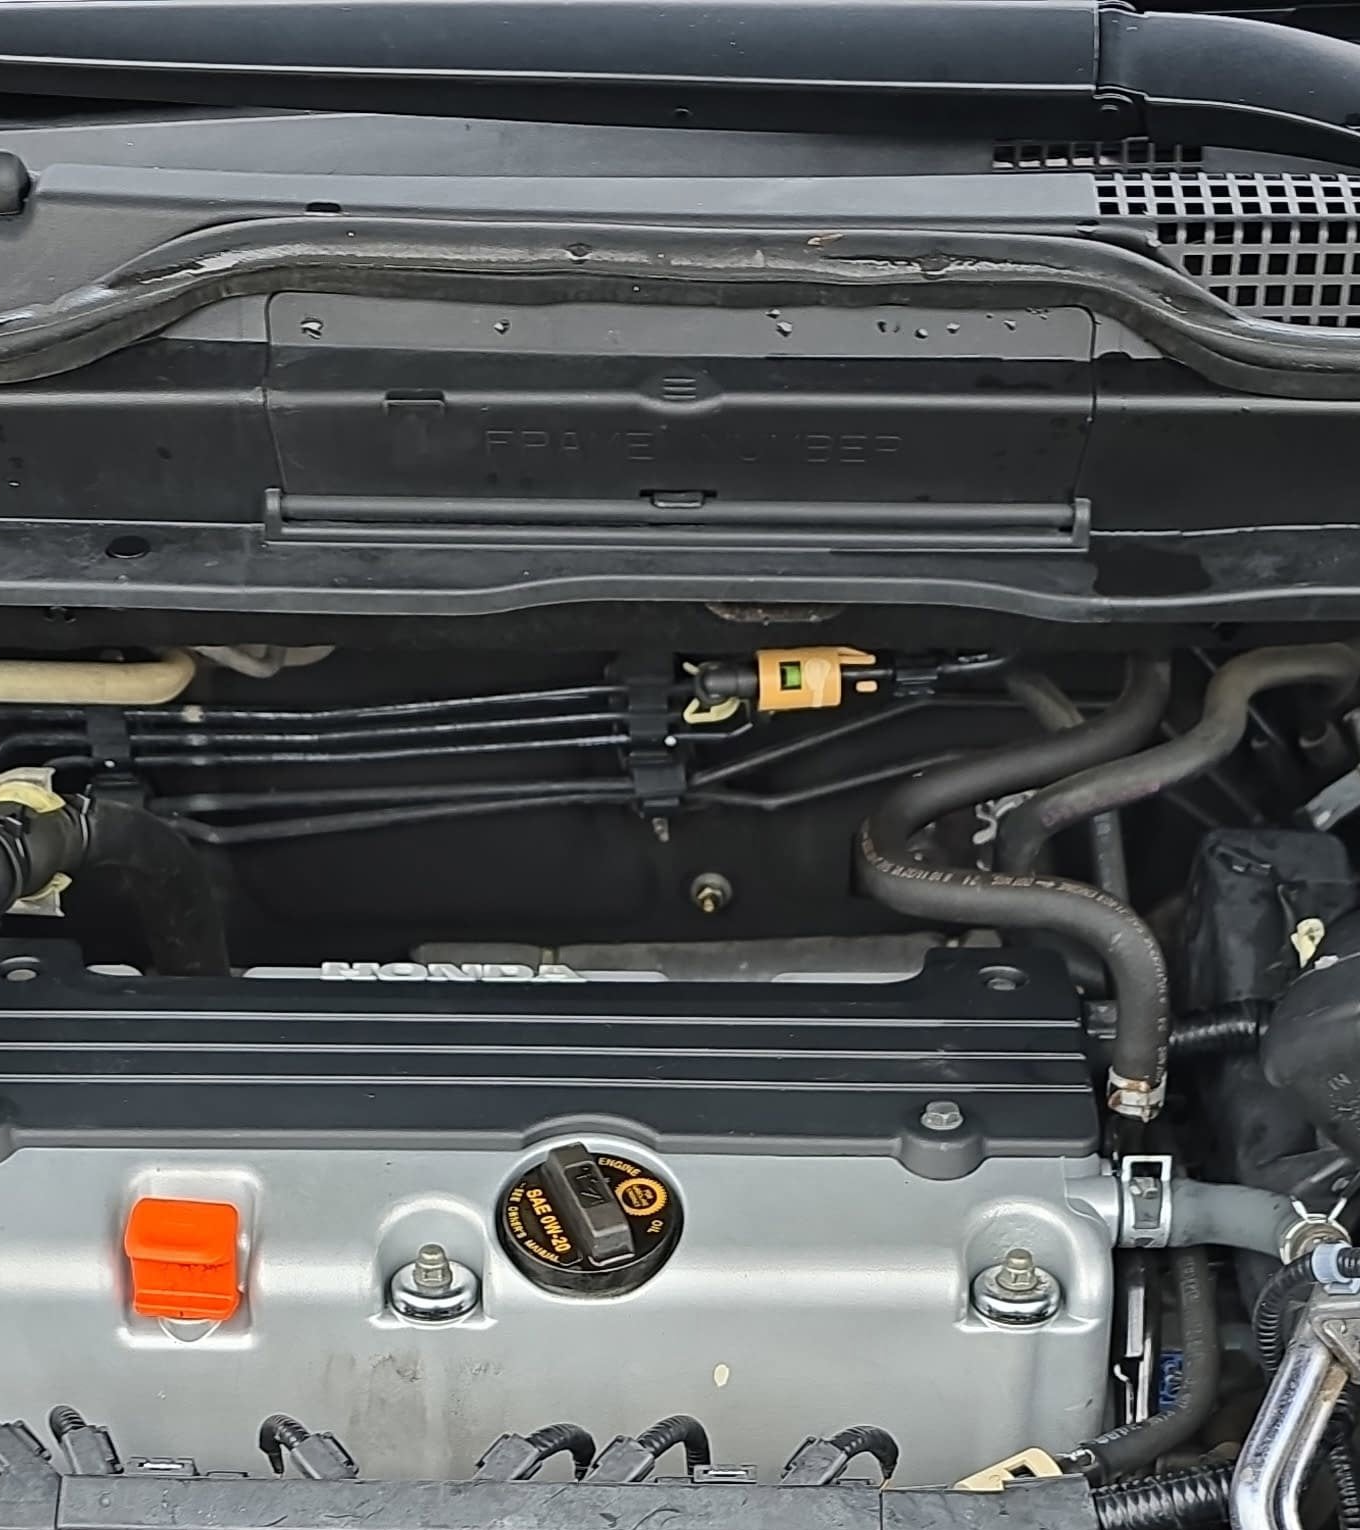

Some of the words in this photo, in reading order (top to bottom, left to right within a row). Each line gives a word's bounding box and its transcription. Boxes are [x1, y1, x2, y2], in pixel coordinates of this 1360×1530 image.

[320, 960, 587, 983] HONDA
[526, 1188, 547, 1216] SAE
[540, 1215, 572, 1253] 0W-20
[597, 1156, 643, 1177] ENGINE
[646, 1219, 665, 1234] OIL
